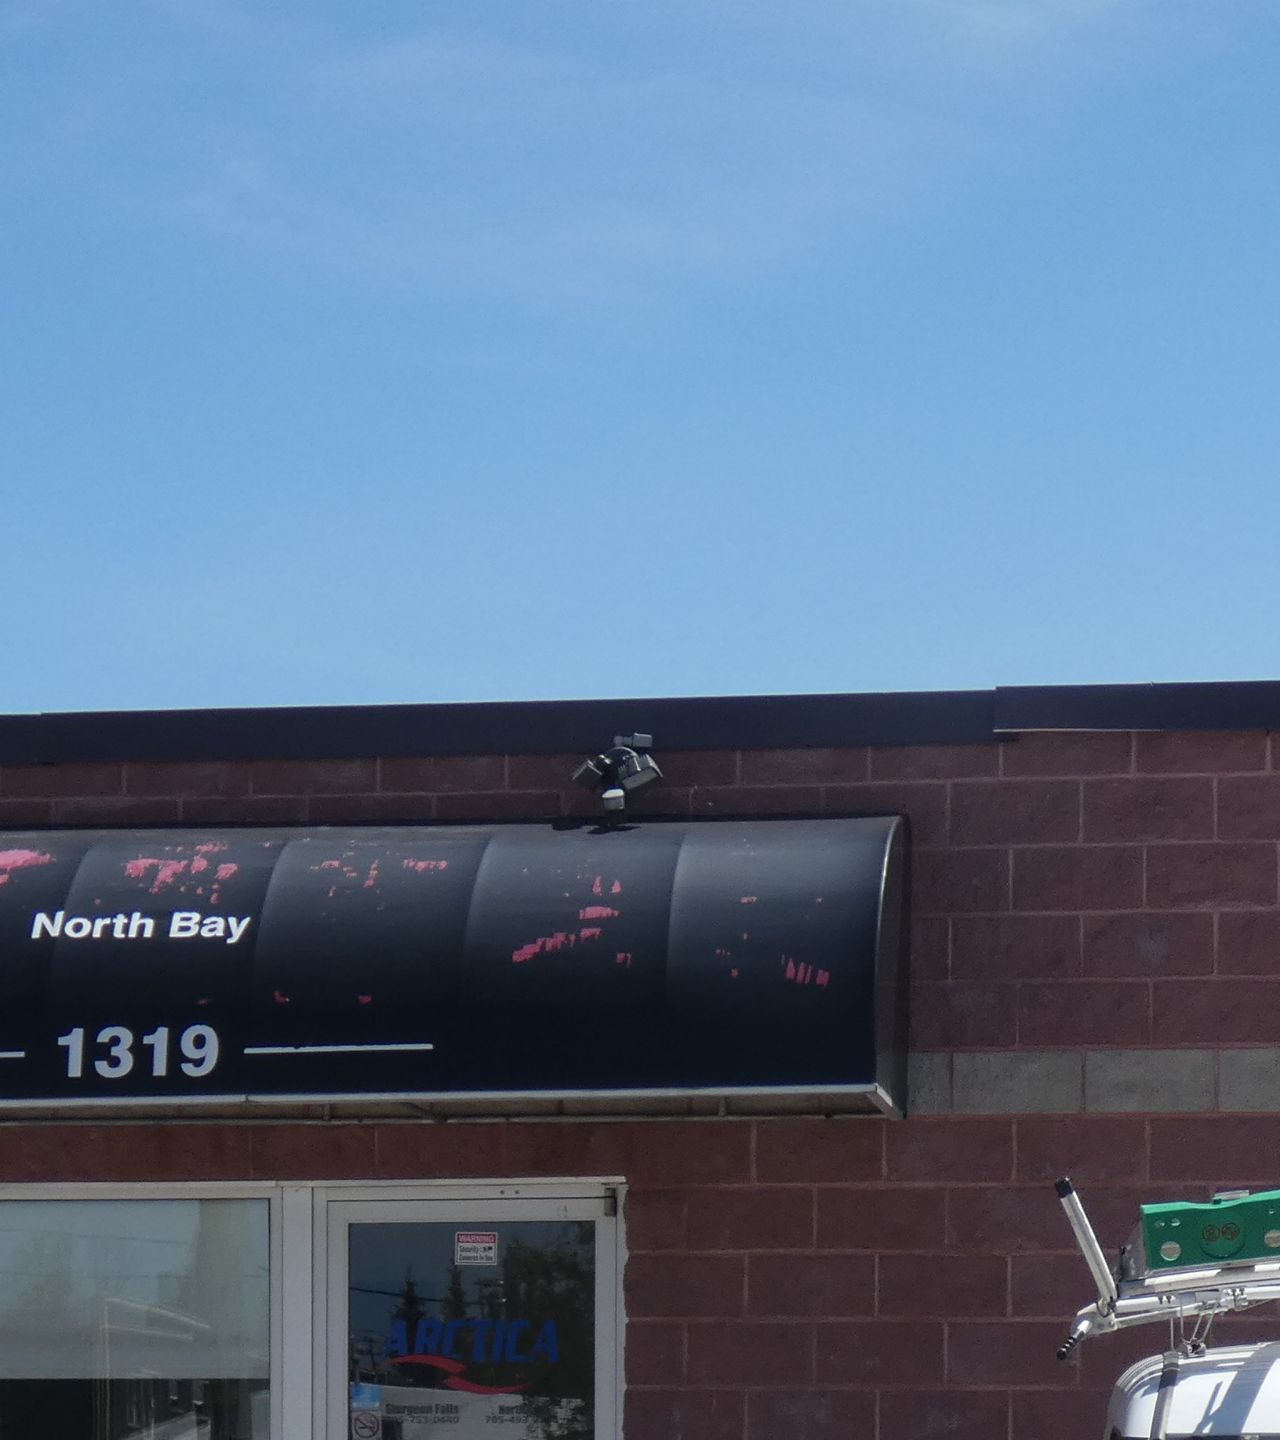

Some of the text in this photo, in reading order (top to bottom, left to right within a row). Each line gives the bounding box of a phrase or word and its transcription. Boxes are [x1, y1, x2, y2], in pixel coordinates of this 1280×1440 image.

[31, 911, 252, 945] North Bay
[57, 1024, 220, 1079] 1319
[382, 1318, 560, 1364] ARCTICA
